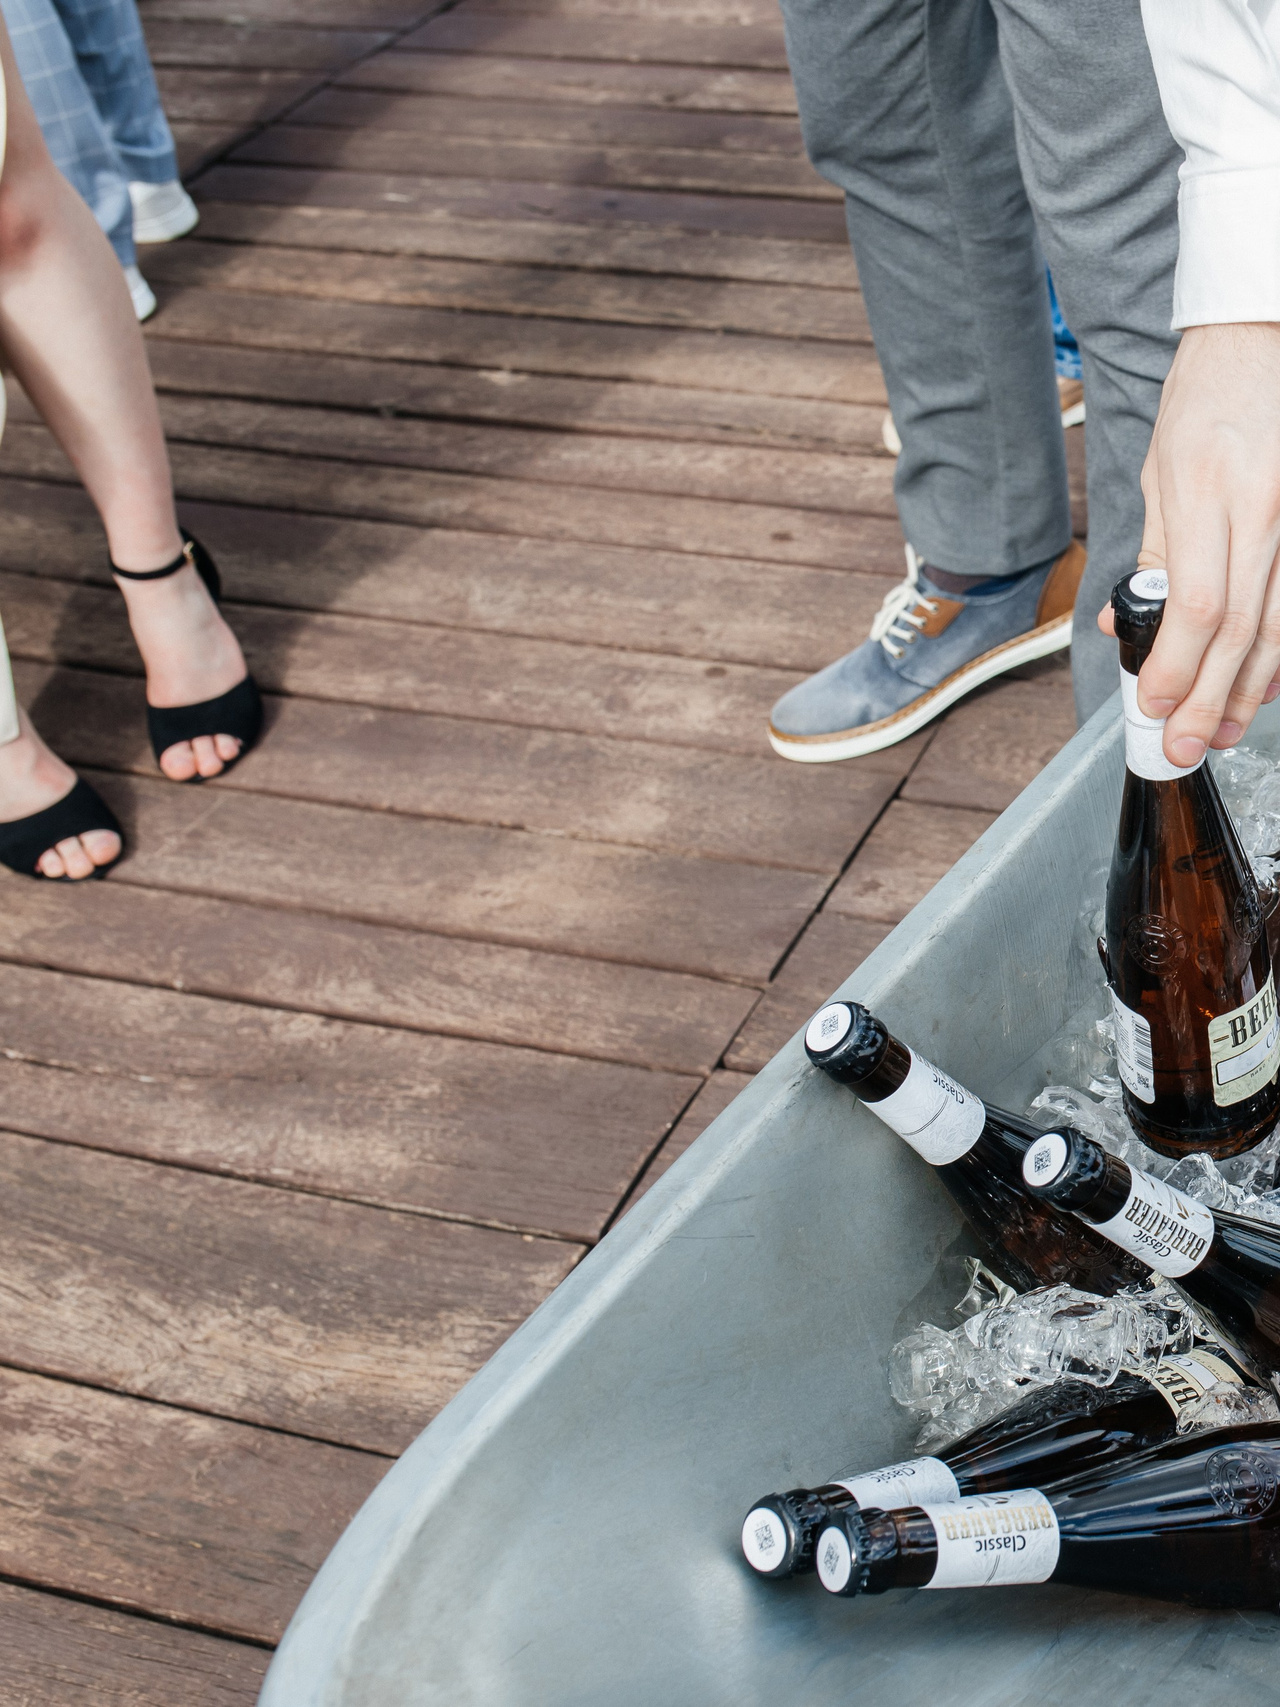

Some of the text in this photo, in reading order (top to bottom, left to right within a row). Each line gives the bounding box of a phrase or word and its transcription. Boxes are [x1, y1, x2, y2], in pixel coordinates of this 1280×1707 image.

[932, 1072, 965, 1105] Classic
[1124, 1195, 1208, 1262] BERGAUER
[1132, 1228, 1172, 1258] Classic
[870, 1466, 916, 1484] Classic
[940, 1503, 1054, 1541] BERGAUER
[975, 1534, 1027, 1556] Classic
